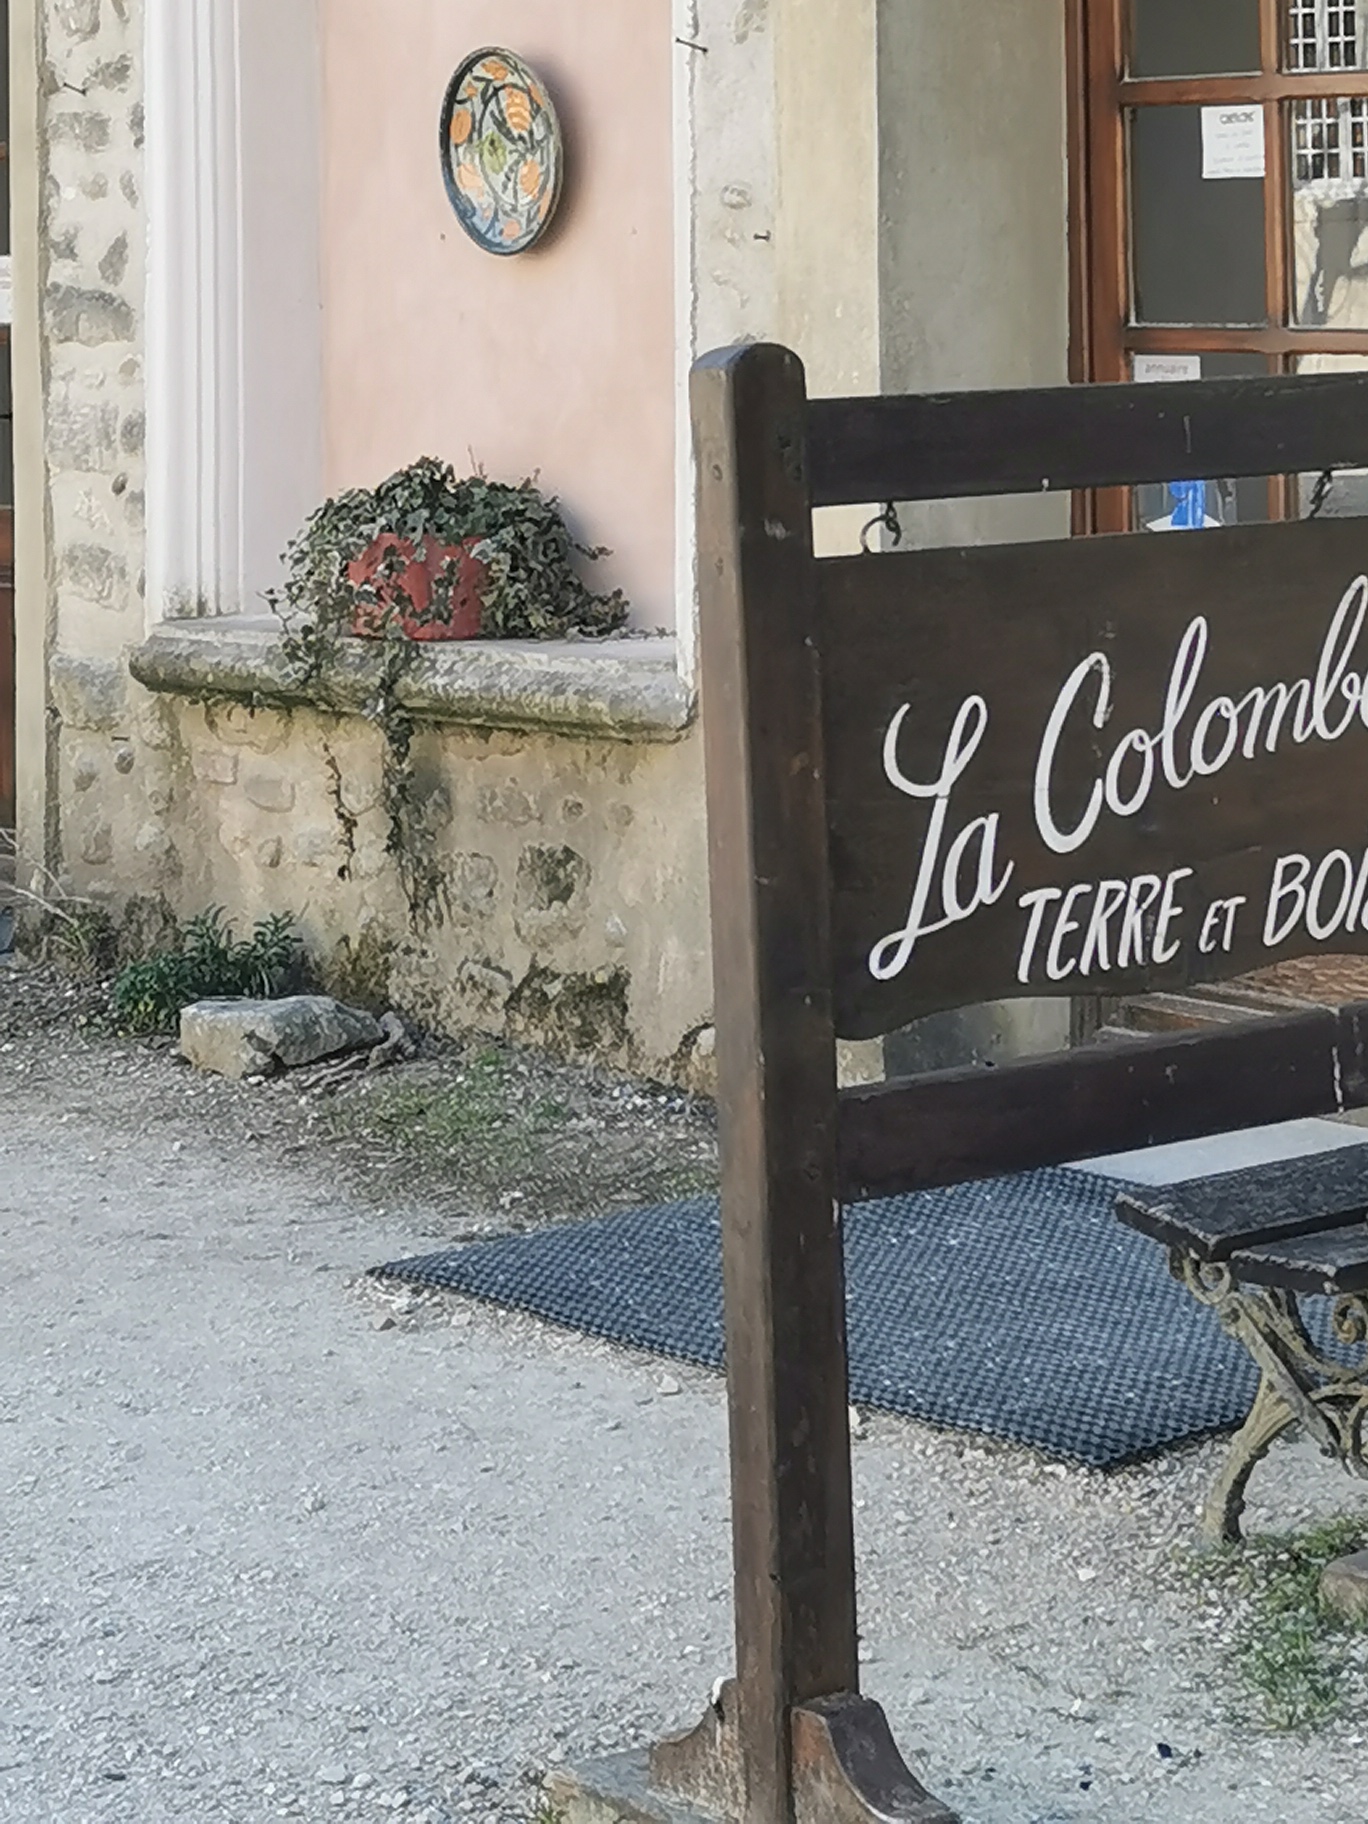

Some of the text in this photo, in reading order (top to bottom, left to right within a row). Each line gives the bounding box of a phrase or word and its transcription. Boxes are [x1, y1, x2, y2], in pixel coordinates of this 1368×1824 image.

[868, 694, 1015, 981] La
[1016, 867, 1194, 984] TERRE
[1199, 896, 1245, 954] ET
